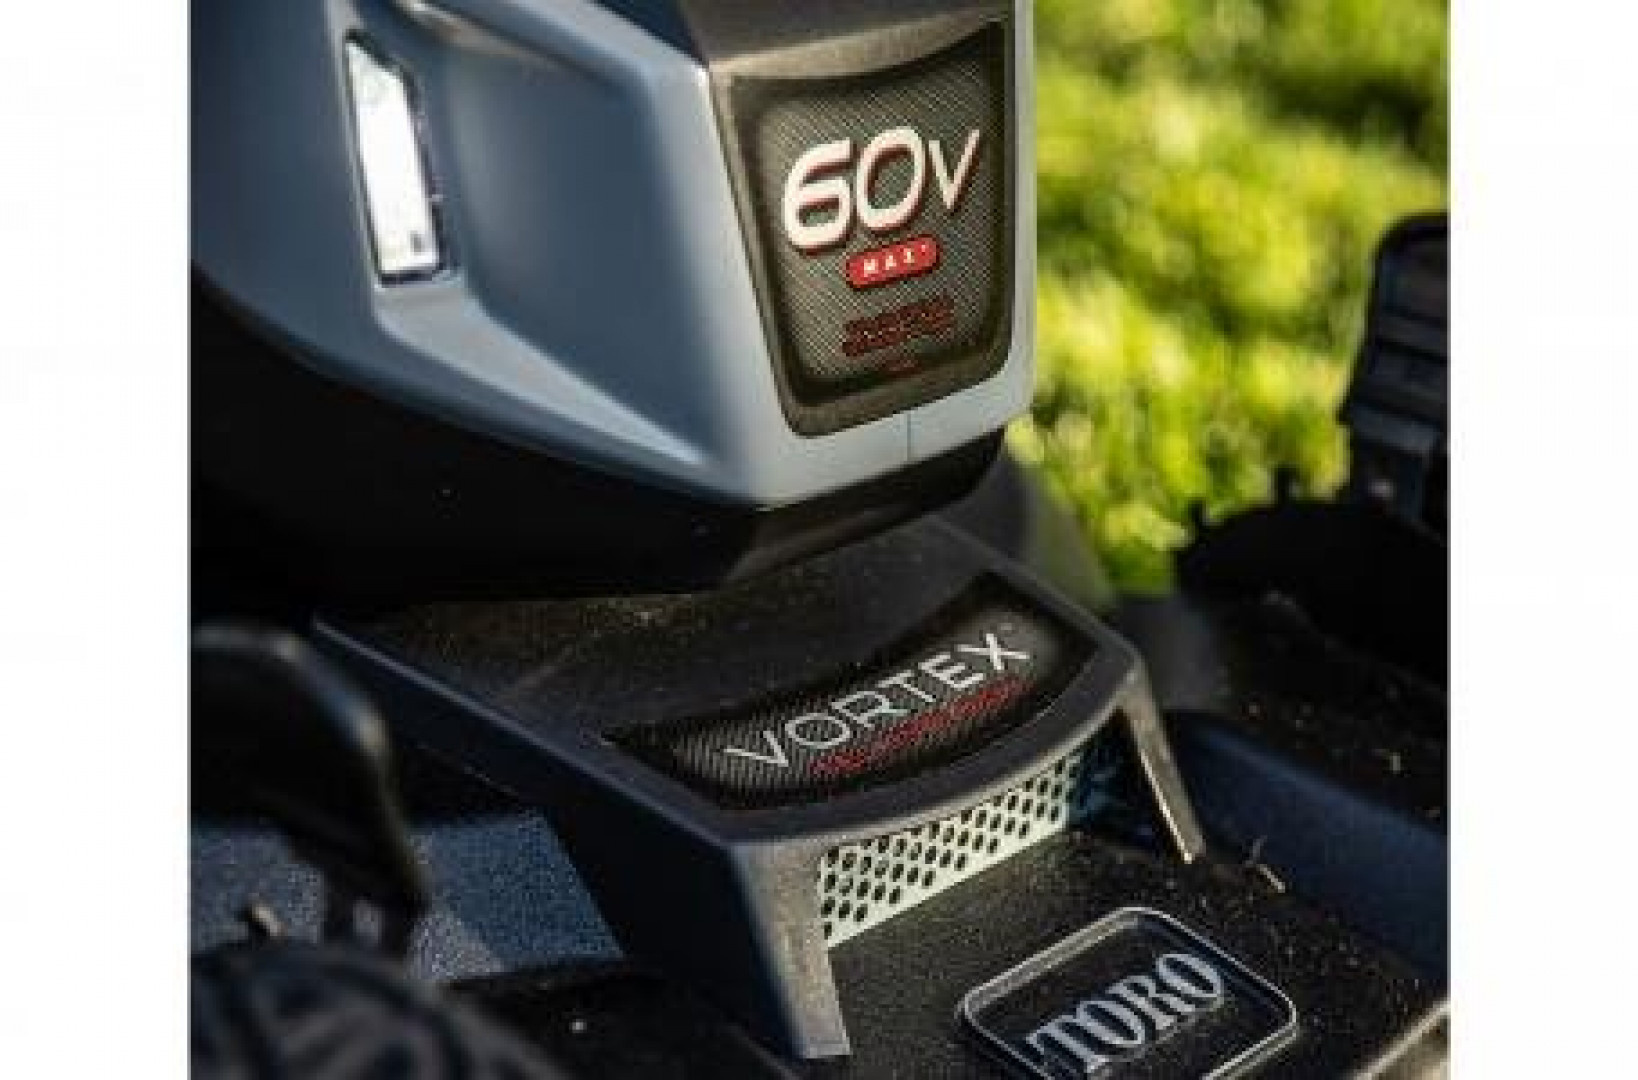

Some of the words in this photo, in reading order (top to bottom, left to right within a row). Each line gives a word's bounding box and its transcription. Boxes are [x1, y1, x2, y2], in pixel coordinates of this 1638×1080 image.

[784, 127, 980, 249] 60V
[724, 633, 1031, 768] VORTEX
[1026, 953, 1225, 1074] TORO
